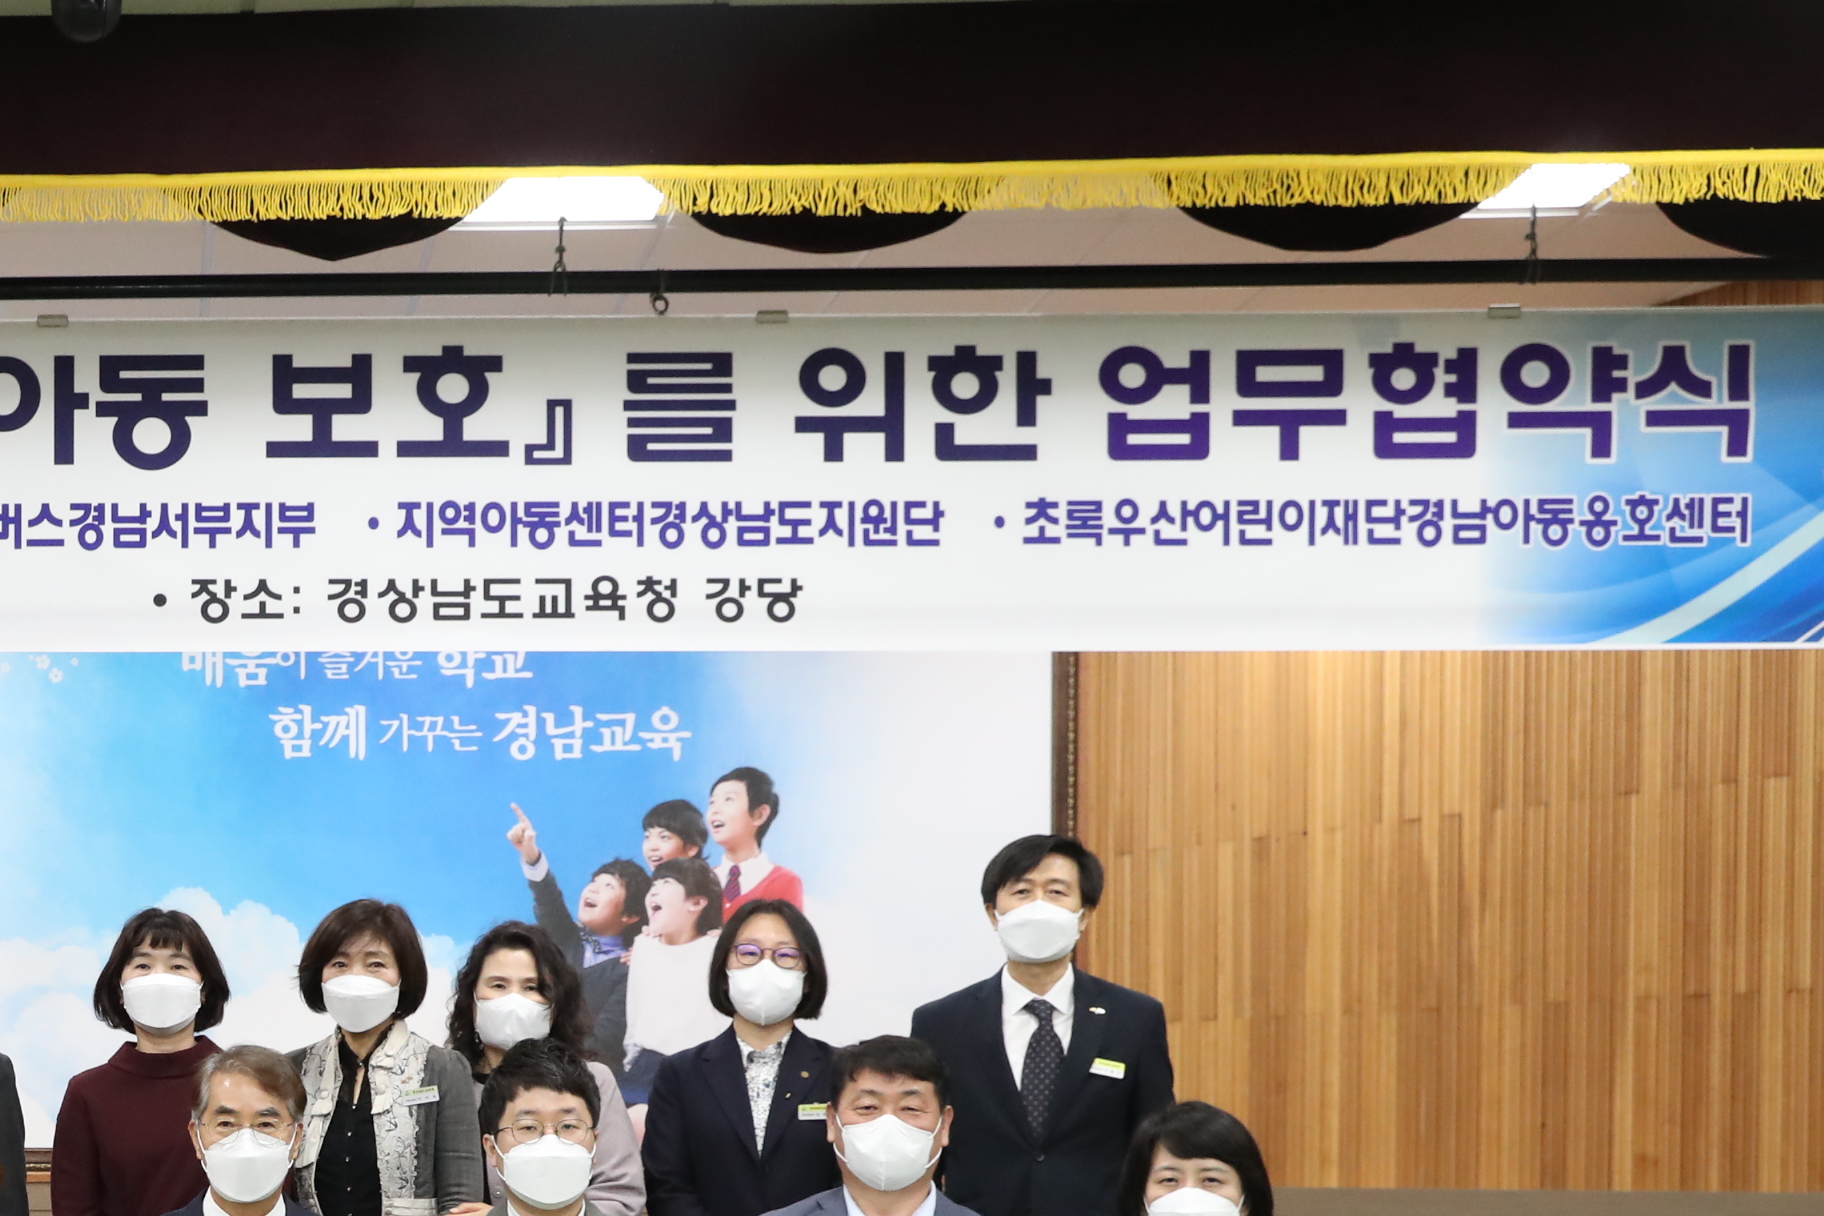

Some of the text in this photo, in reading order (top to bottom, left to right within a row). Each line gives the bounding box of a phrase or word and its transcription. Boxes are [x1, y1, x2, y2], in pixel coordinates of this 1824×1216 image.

[795, 345, 1053, 462] 위한
[1098, 341, 1754, 463] 업무협약식
[397, 500, 945, 549] 지역아동센터경상남도지원단
[1023, 494, 1750, 550] 초록우산어린이재단경남아동옹호센터
[191, 576, 803, 624] 장소: 경상남도교육청 강당
[268, 704, 693, 762] 함께 가꾸는 경남교육
